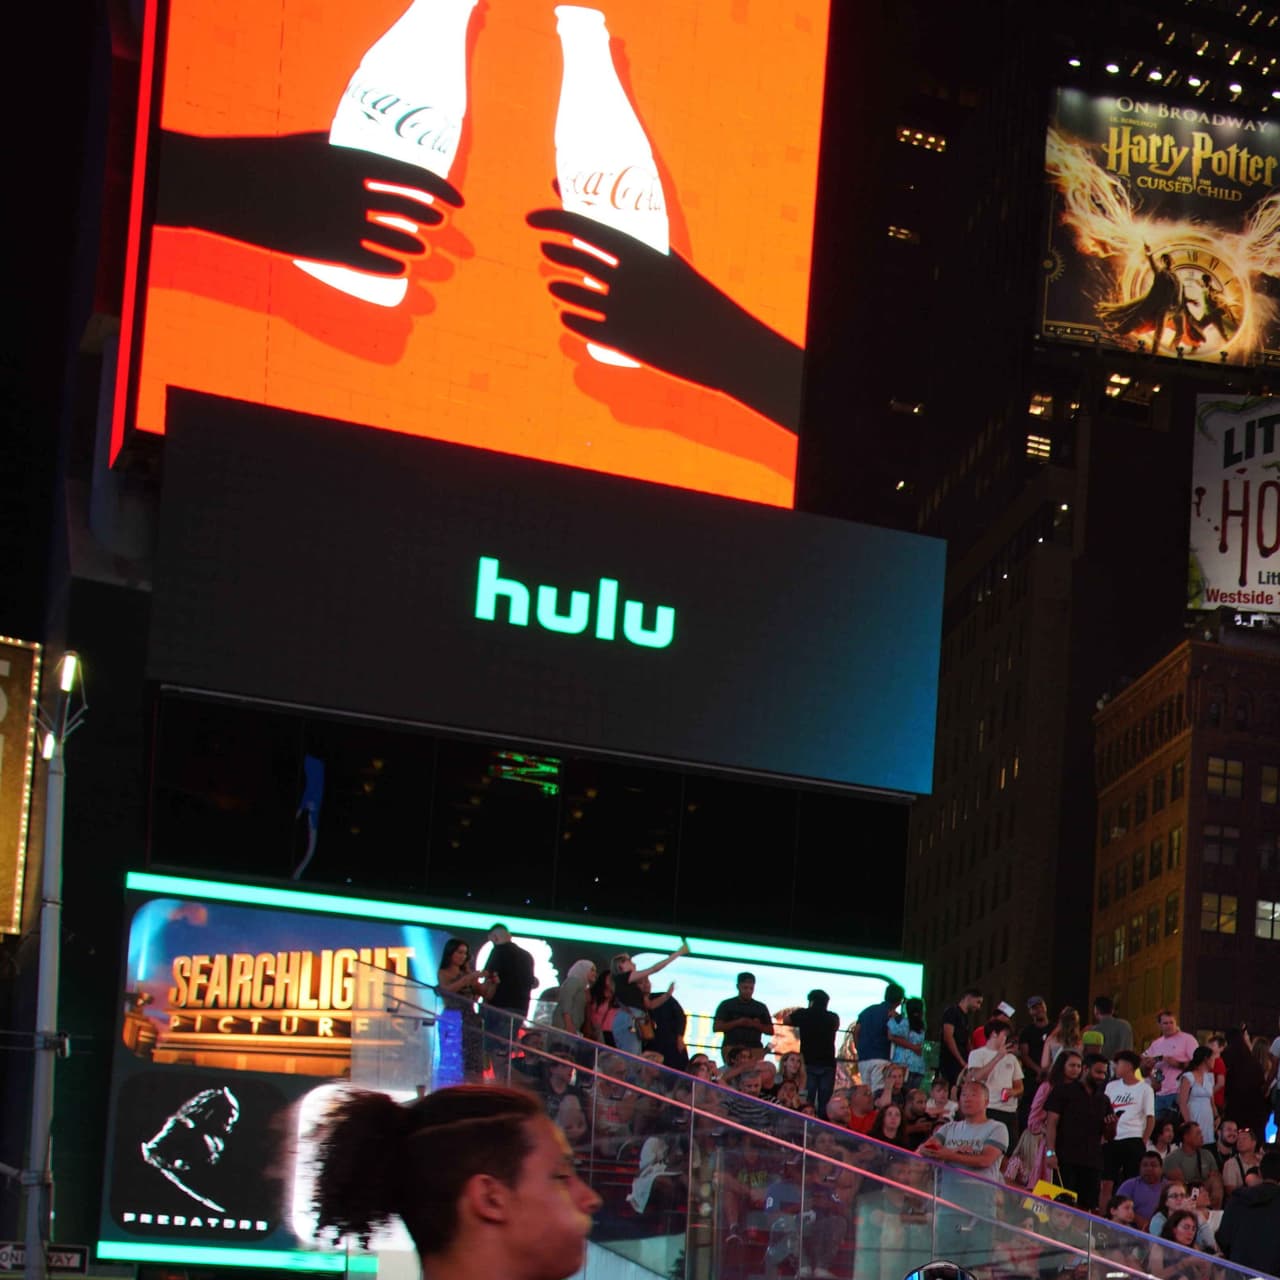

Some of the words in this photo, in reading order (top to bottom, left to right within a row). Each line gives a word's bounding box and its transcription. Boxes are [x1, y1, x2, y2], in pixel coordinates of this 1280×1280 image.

[1157, 103, 1269, 133] BROADWAY
[1101, 126, 1189, 177] Harry
[1191, 131, 1278, 191] Potter
[1137, 176, 1193, 194] CURSED
[1197, 185, 1242, 201] CHILD
[475, 557, 675, 649] hulu
[1206, 588, 1273, 605] Westside
[167, 946, 415, 1010] SEARCHLIGHT
[0, 1253, 26, 1267] ON
